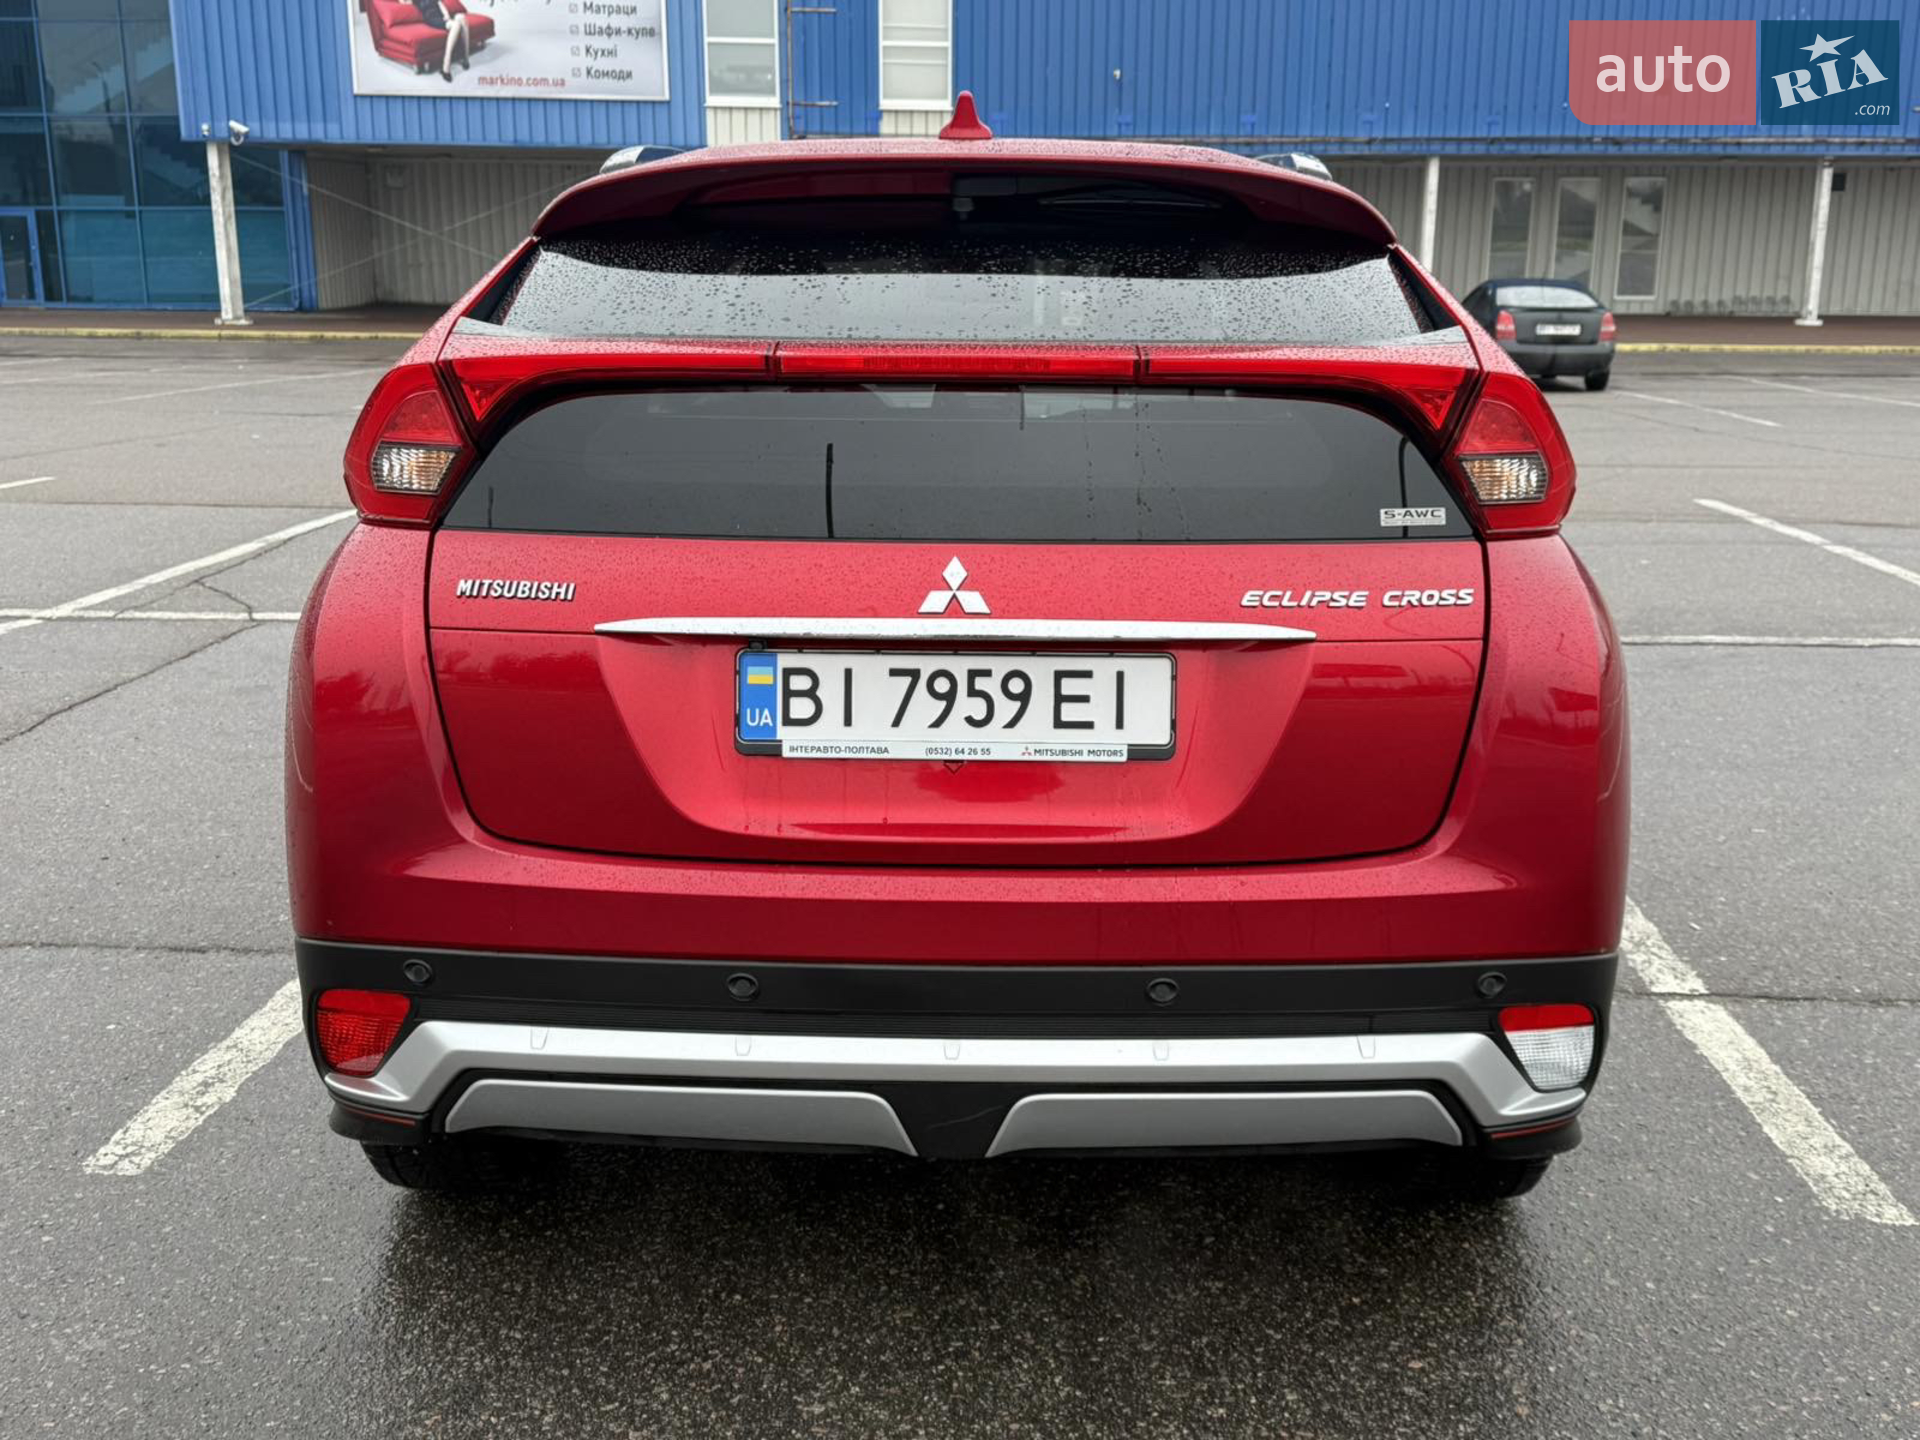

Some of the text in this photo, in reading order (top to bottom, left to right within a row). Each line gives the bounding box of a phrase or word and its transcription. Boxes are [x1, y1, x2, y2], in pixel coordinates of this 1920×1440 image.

[583, 2, 637, 17] Матраци
[584, 22, 656, 40] Шафи-купе
[585, 44, 618, 61] Кухні
[478, 75, 566, 88] markino.com.ua
[586, 66, 633, 82] Комоди
[1383, 509, 1442, 519] S-AWC
[456, 578, 576, 601] MITSUBISHI
[1241, 588, 1474, 607] ECLIPSE CROSS
[782, 667, 1125, 730] BI 7959 EI
[746, 708, 773, 727] UA
[789, 745, 890, 755] ІНТЕРАВТО-ПОЛТАВА
[925, 747, 991, 756] (0532) 64 26 55
[1033, 749, 1124, 758] MITSUBISHI MOTORS
